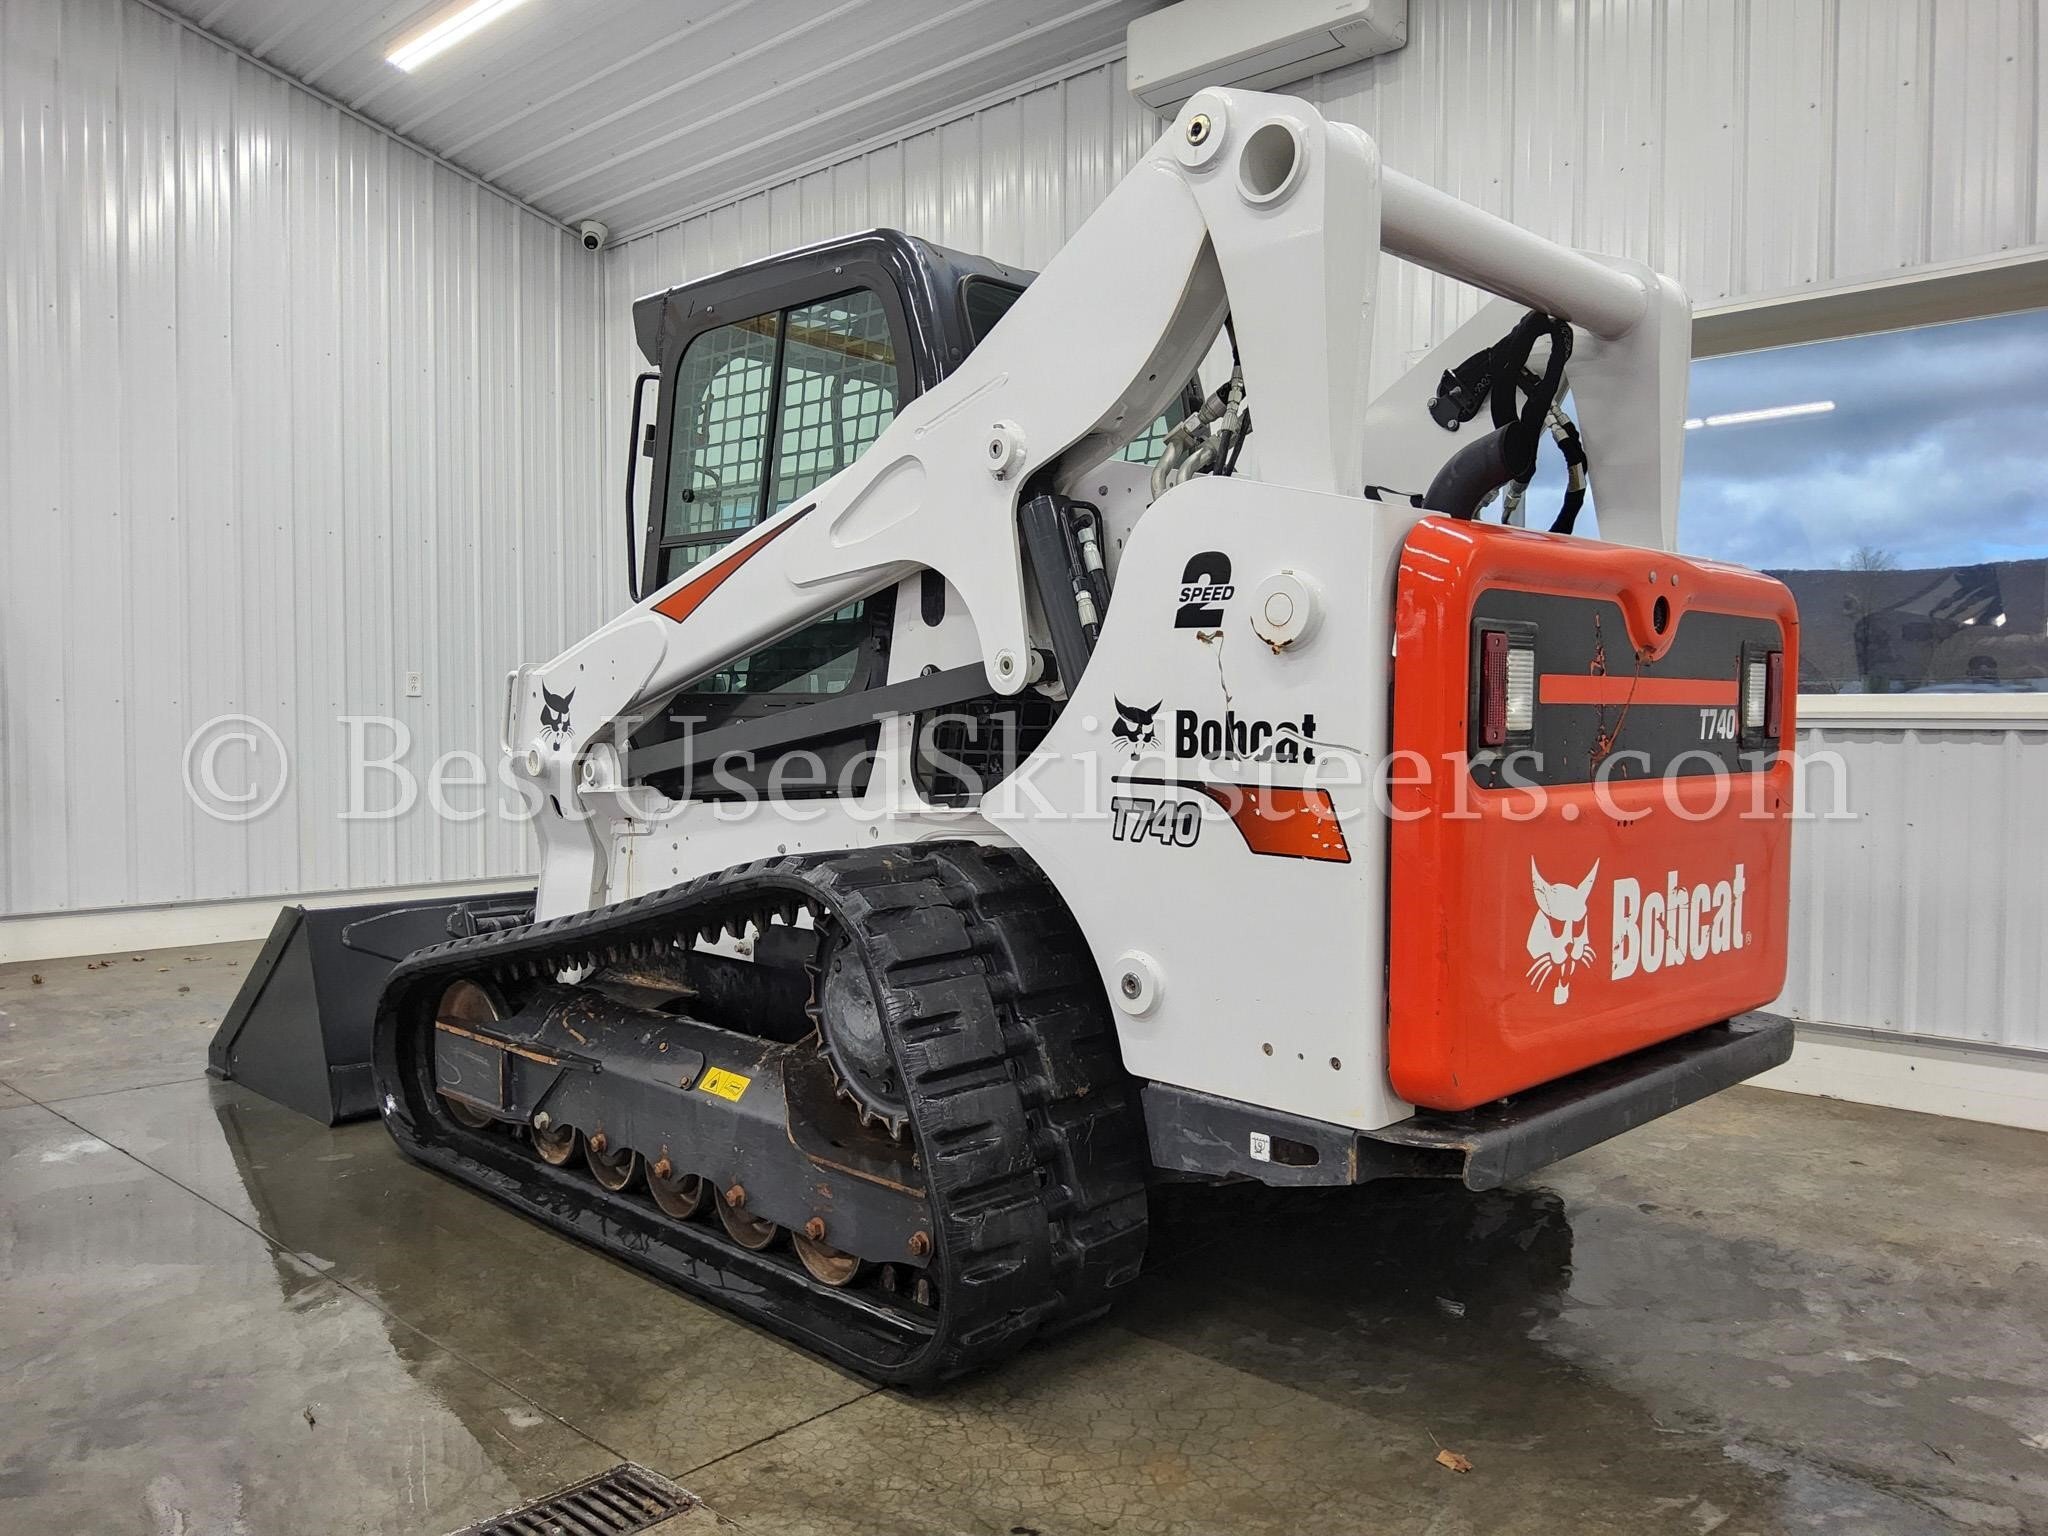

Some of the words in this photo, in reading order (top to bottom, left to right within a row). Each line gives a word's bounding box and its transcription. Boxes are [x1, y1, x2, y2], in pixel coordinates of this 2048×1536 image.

[1174, 551, 1232, 628] 2
[1179, 585, 1235, 602] SPEED
[1176, 709, 1316, 764] Bobcat
[1700, 709, 1736, 740] T740
[1111, 796, 1201, 848] T740
[1611, 864, 1746, 980] Bobcat
